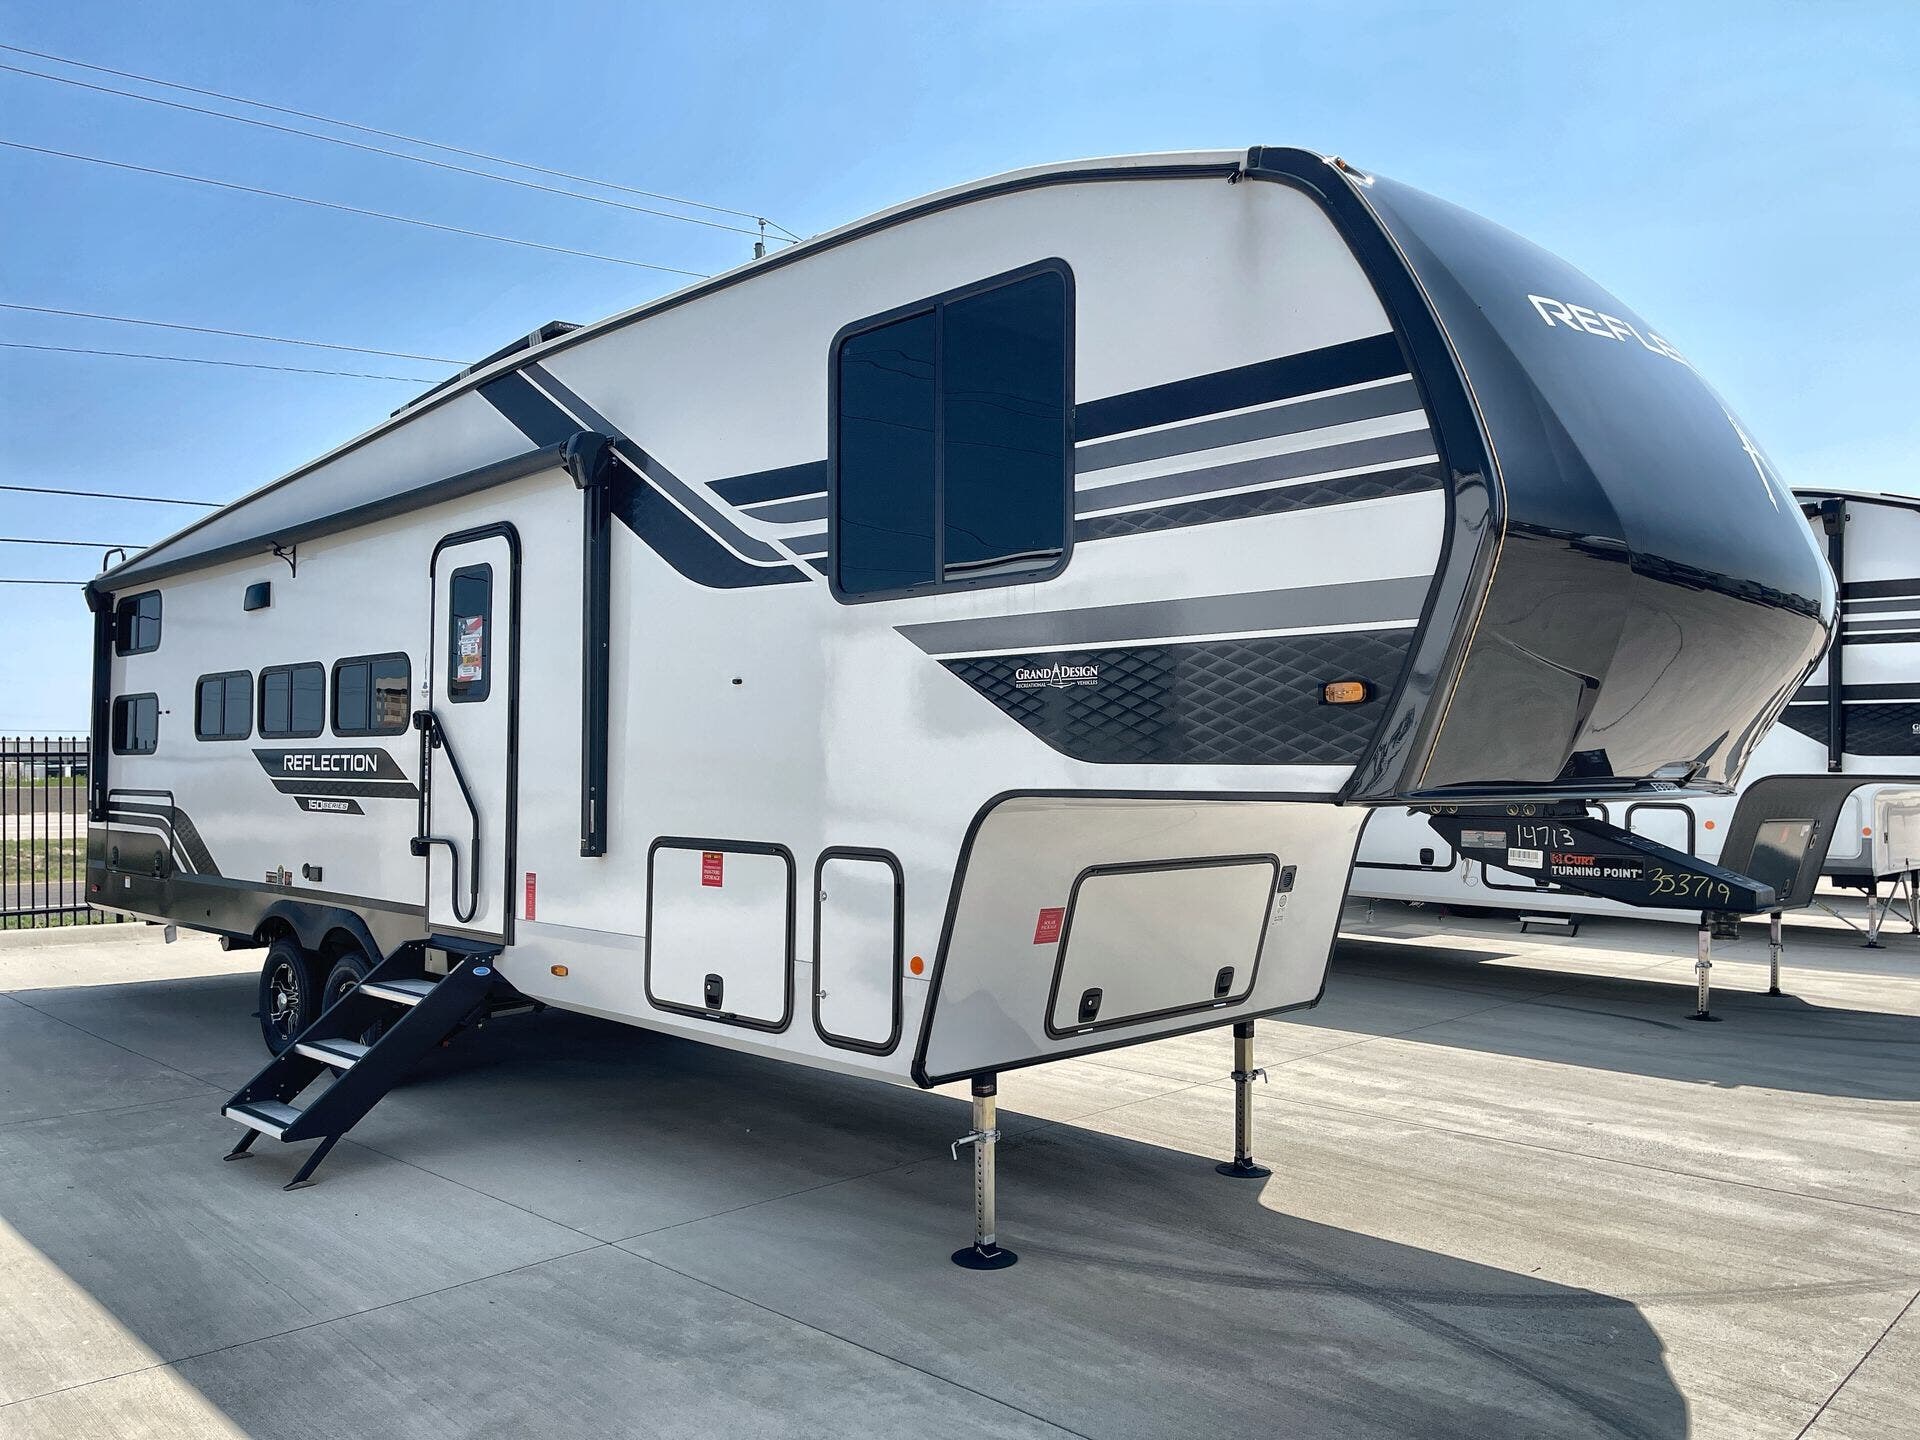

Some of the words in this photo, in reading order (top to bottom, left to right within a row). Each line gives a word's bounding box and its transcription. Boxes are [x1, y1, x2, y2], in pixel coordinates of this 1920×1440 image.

[1527, 294, 1704, 379] REFLE
[1015, 668, 1051, 680] GRAND
[1061, 665, 1099, 678] DESIGN
[283, 754, 377, 772] REFLECTION
[308, 799, 323, 810] 150
[322, 801, 348, 810] SERIES
[1517, 824, 1575, 848] 14713
[1551, 865, 1601, 877] TURNING
[1647, 868, 1730, 904] 353719
